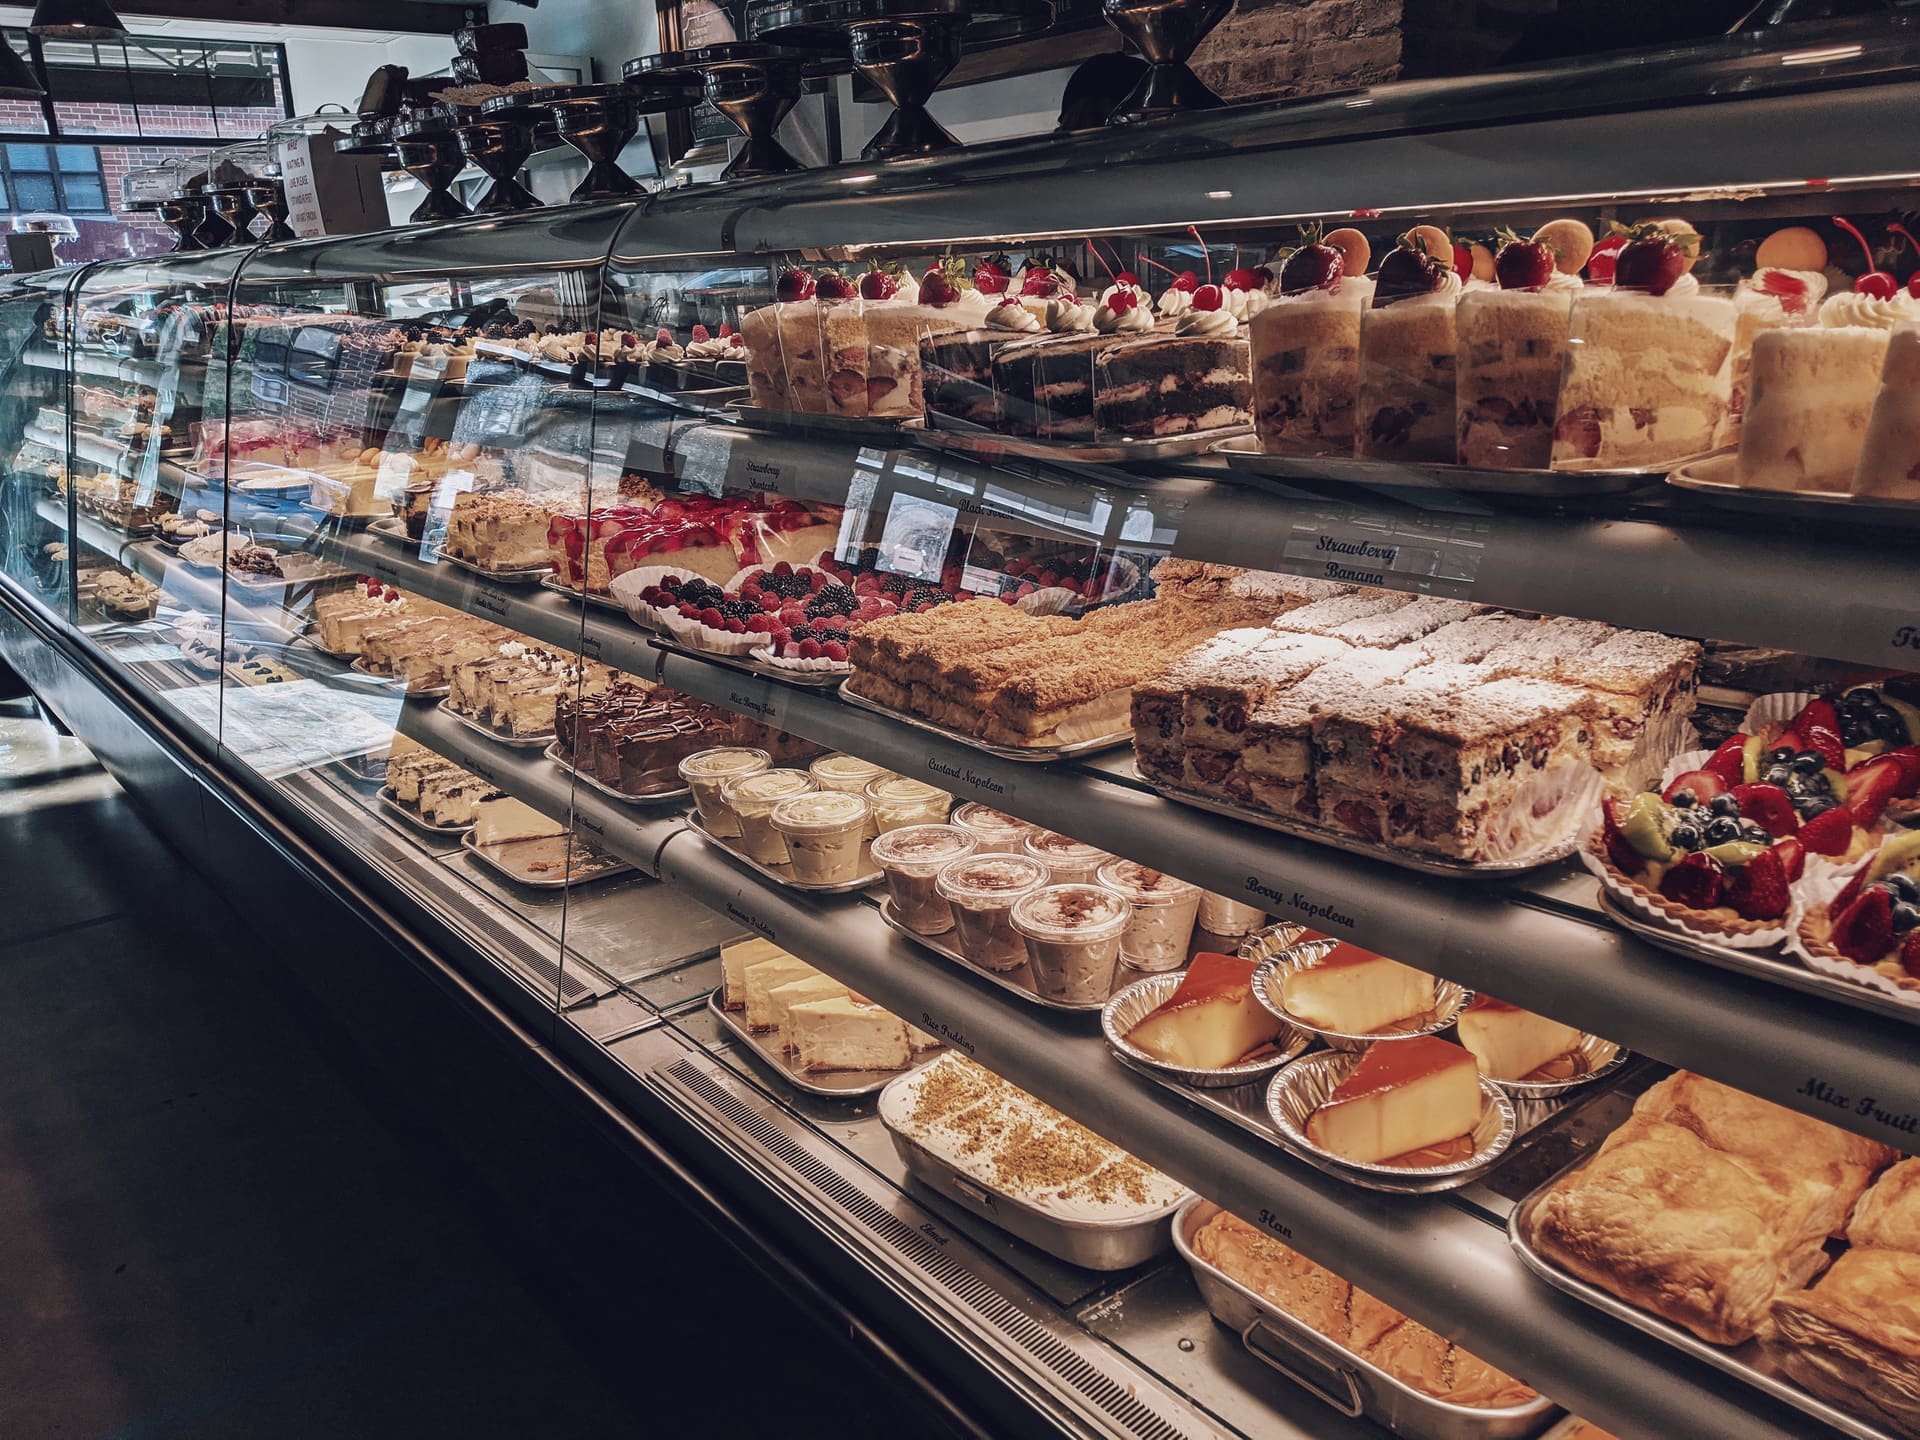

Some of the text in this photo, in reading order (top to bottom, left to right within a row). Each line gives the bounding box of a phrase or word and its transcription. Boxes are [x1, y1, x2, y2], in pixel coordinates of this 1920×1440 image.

[1316, 535, 1398, 564] Strawberry
[1325, 562, 1384, 585] Banana
[928, 758, 1004, 794] Custard Napoleon
[1245, 876, 1355, 928] Berry Napoleon
[922, 1012, 976, 1055] Rice Pudding
[1796, 1078, 1919, 1134] Mix Fruit
[1258, 1209, 1293, 1239] Flan
